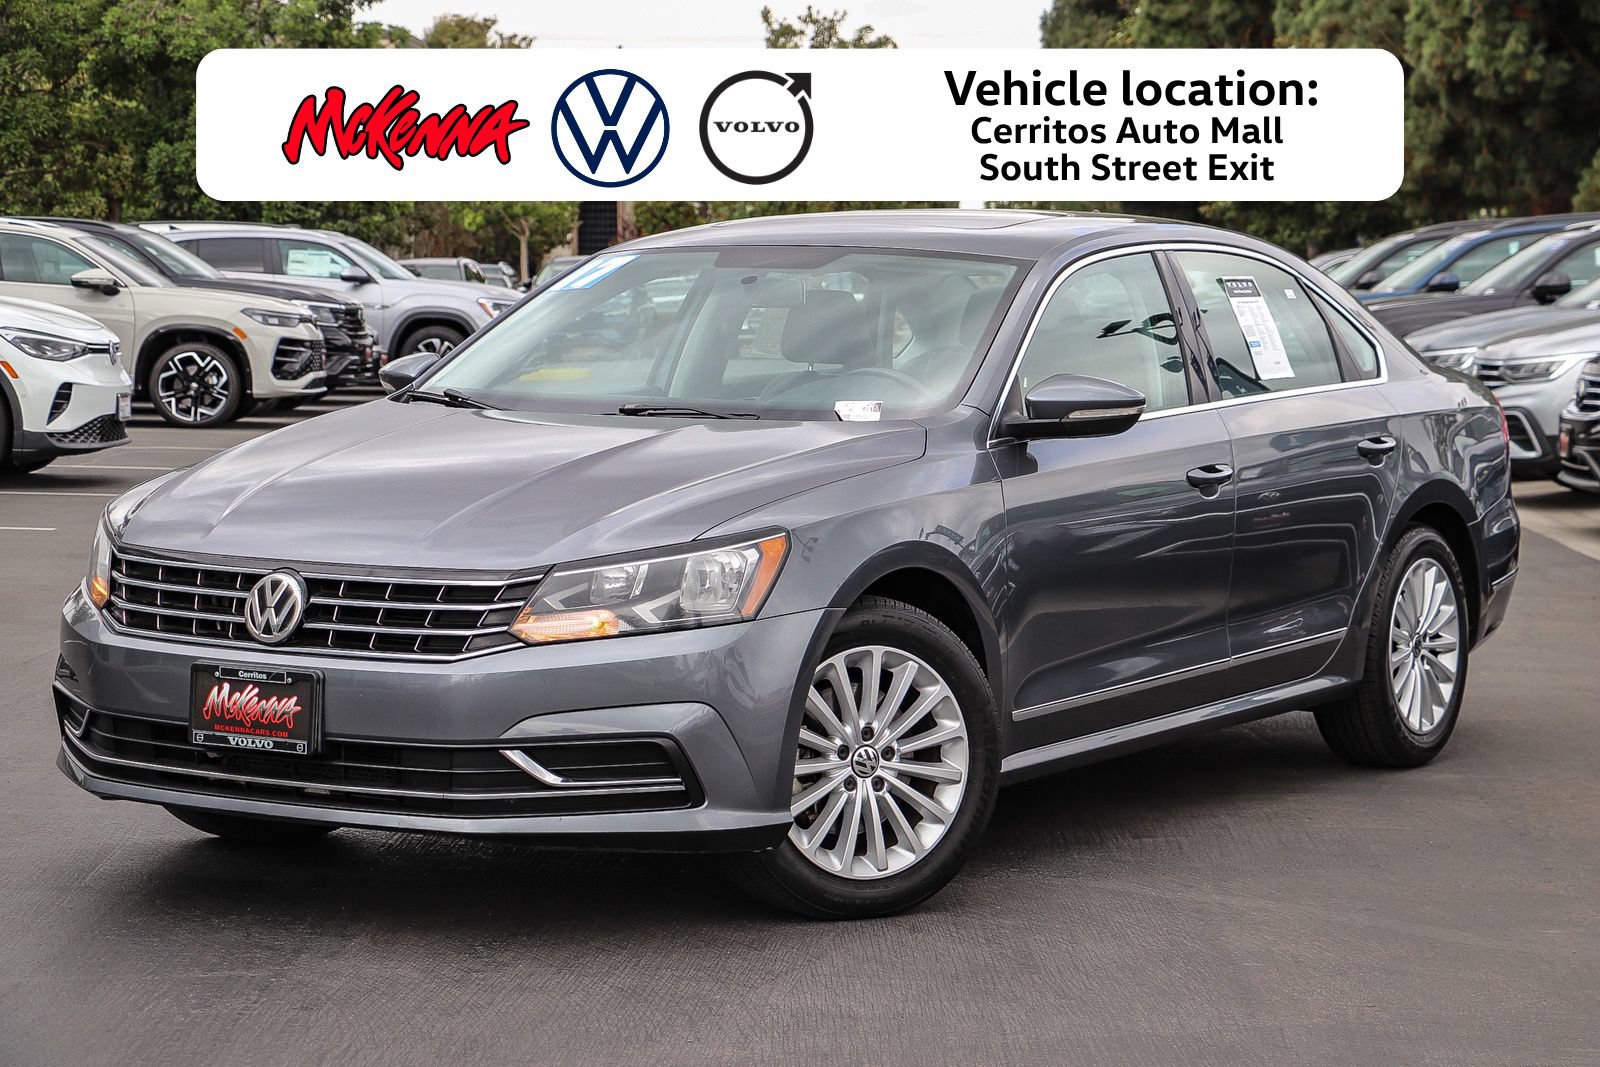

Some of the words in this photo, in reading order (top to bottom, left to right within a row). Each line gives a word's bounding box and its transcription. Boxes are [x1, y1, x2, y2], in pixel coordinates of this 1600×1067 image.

[238, 670, 267, 680] Cerritos
[214, 723, 288, 738] MCKENNACARS.COM
[227, 736, 274, 749] VOLVO
